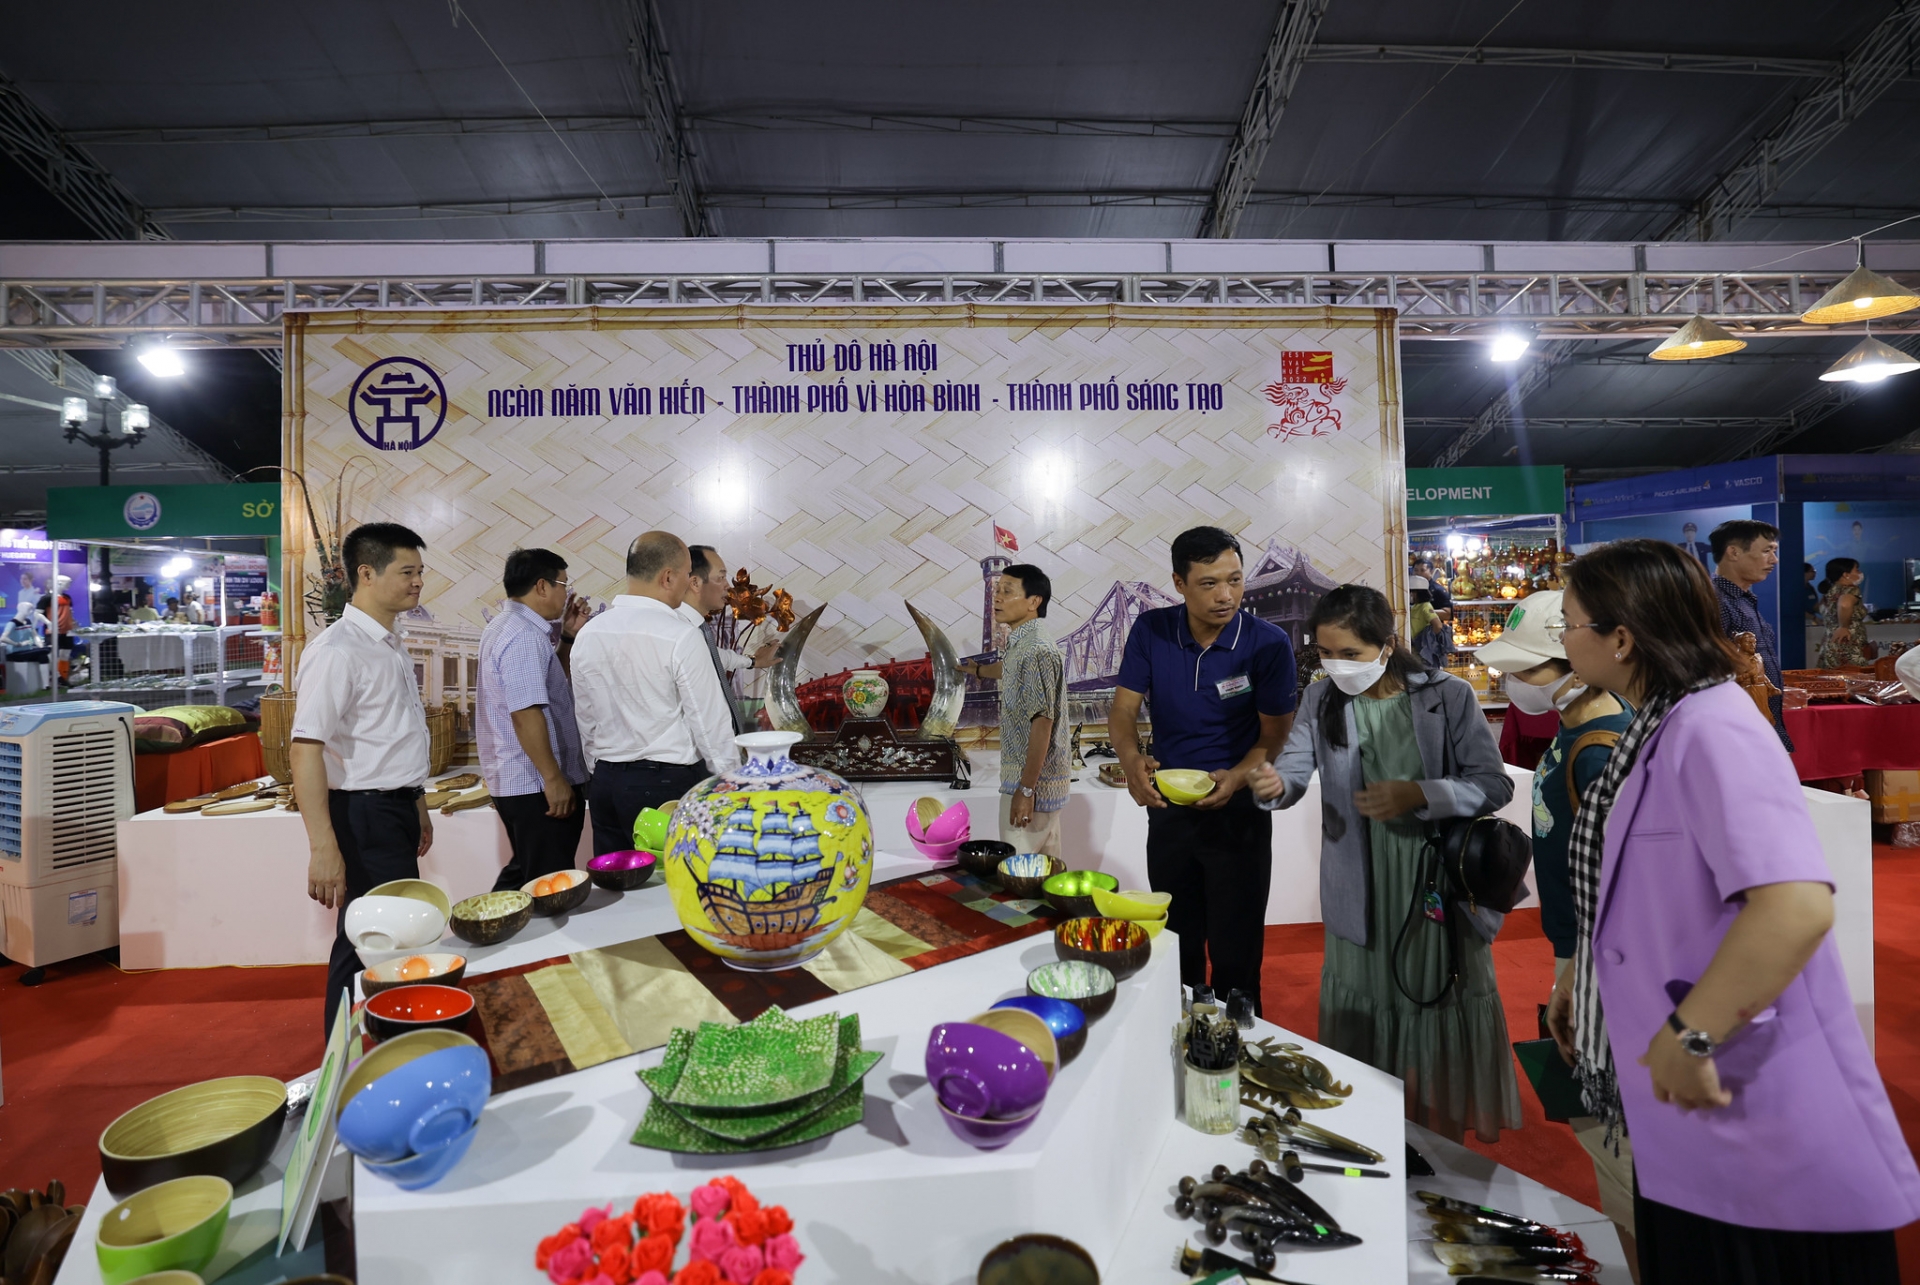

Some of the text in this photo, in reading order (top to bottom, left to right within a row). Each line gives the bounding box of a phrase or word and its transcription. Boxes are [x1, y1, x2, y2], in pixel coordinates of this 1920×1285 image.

[786, 338, 938, 376] THỦ ĐÔ HÀ NỘI
[488, 384, 544, 417] NGÀN
[552, 383, 601, 416] NĂM
[608, 382, 652, 415] VĂN
[659, 379, 705, 415] HIẾN
[732, 381, 800, 413] THÀNH
[807, 377, 849, 413] PHỐ
[856, 380, 878, 412] VÌ
[884, 380, 926, 412] HÒA
[933, 379, 981, 412] BÌNH
[1007, 379, 1072, 411] THÀNH
[1079, 376, 1120, 411] PHỐ
[1126, 379, 1179, 410] SÁNG
[1185, 383, 1223, 415] TẠO
[383, 439, 413, 452] HÀ NỘI
[1733, 476, 1763, 487] VASCO
[242, 499, 275, 518] SỞ
